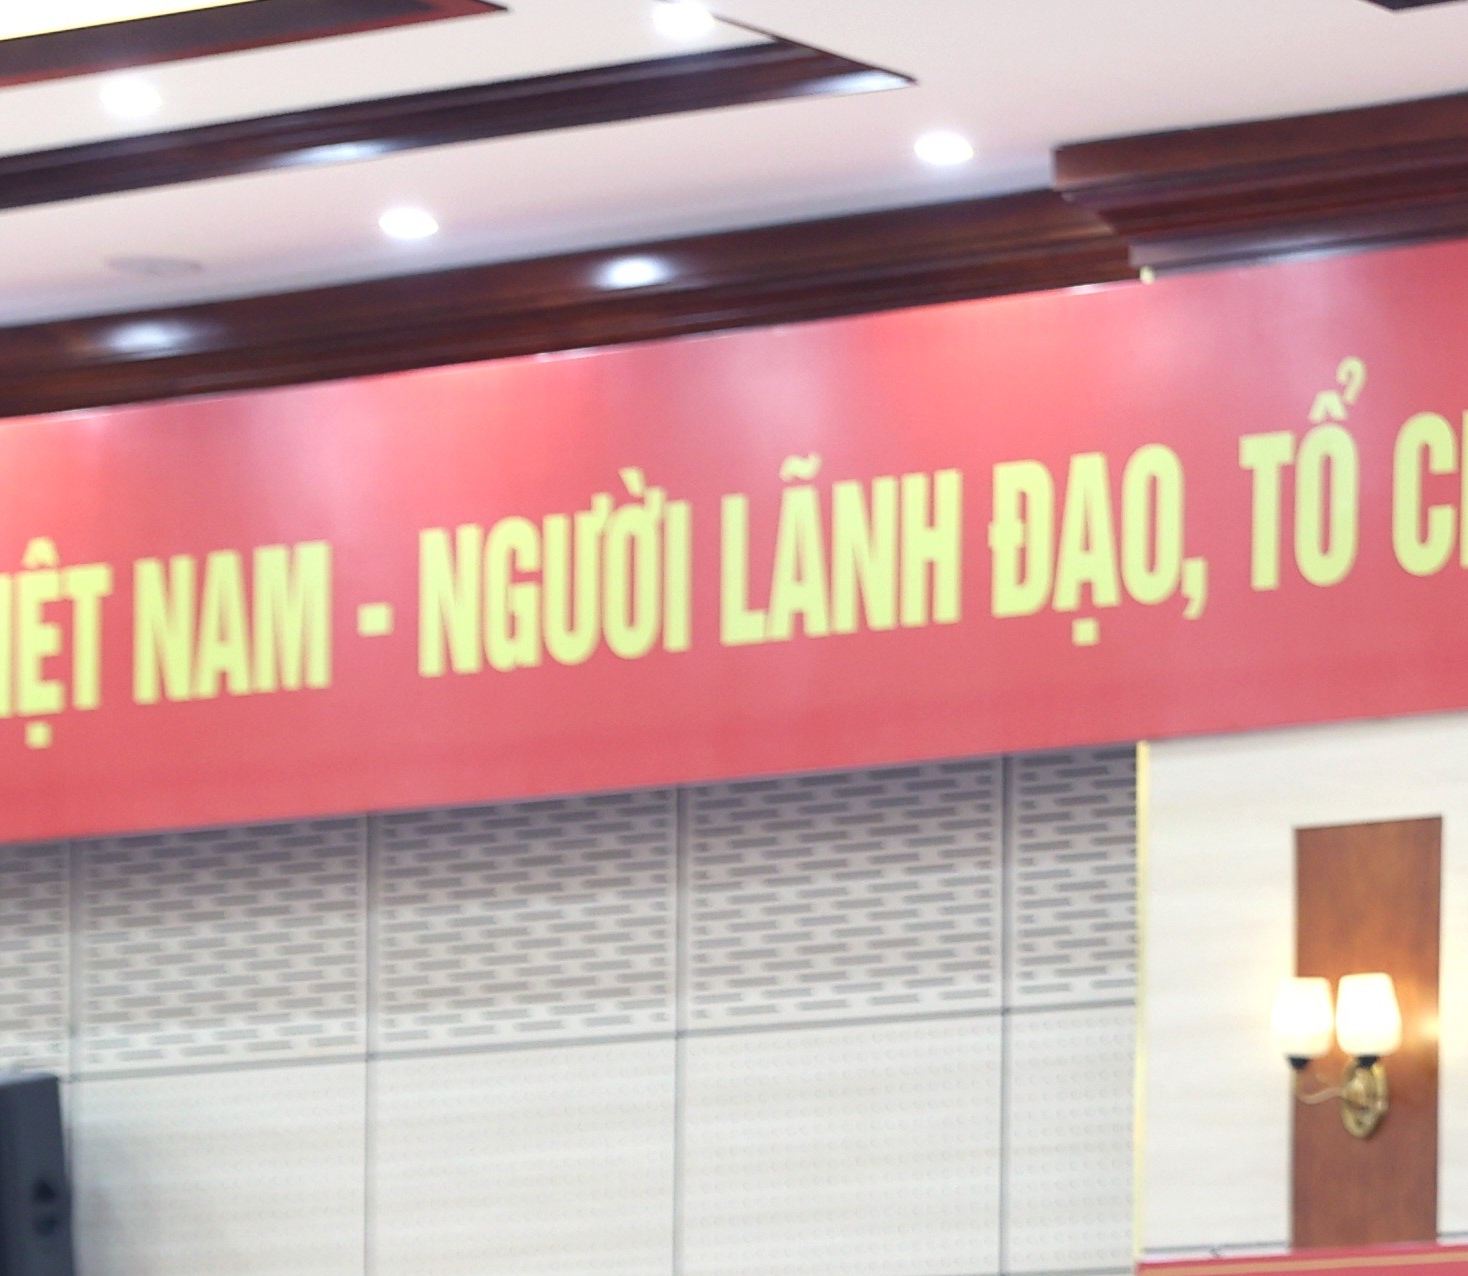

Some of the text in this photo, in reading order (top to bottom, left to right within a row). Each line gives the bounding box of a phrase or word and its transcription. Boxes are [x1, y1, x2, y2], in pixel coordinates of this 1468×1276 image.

[134, 540, 330, 703] NAM
[358, 602, 392, 637] -
[417, 468, 691, 677] NGƯỜI
[721, 453, 962, 646] LÃNH
[988, 444, 1207, 646] ĐẠO,
[1240, 356, 1367, 592] TỔ
